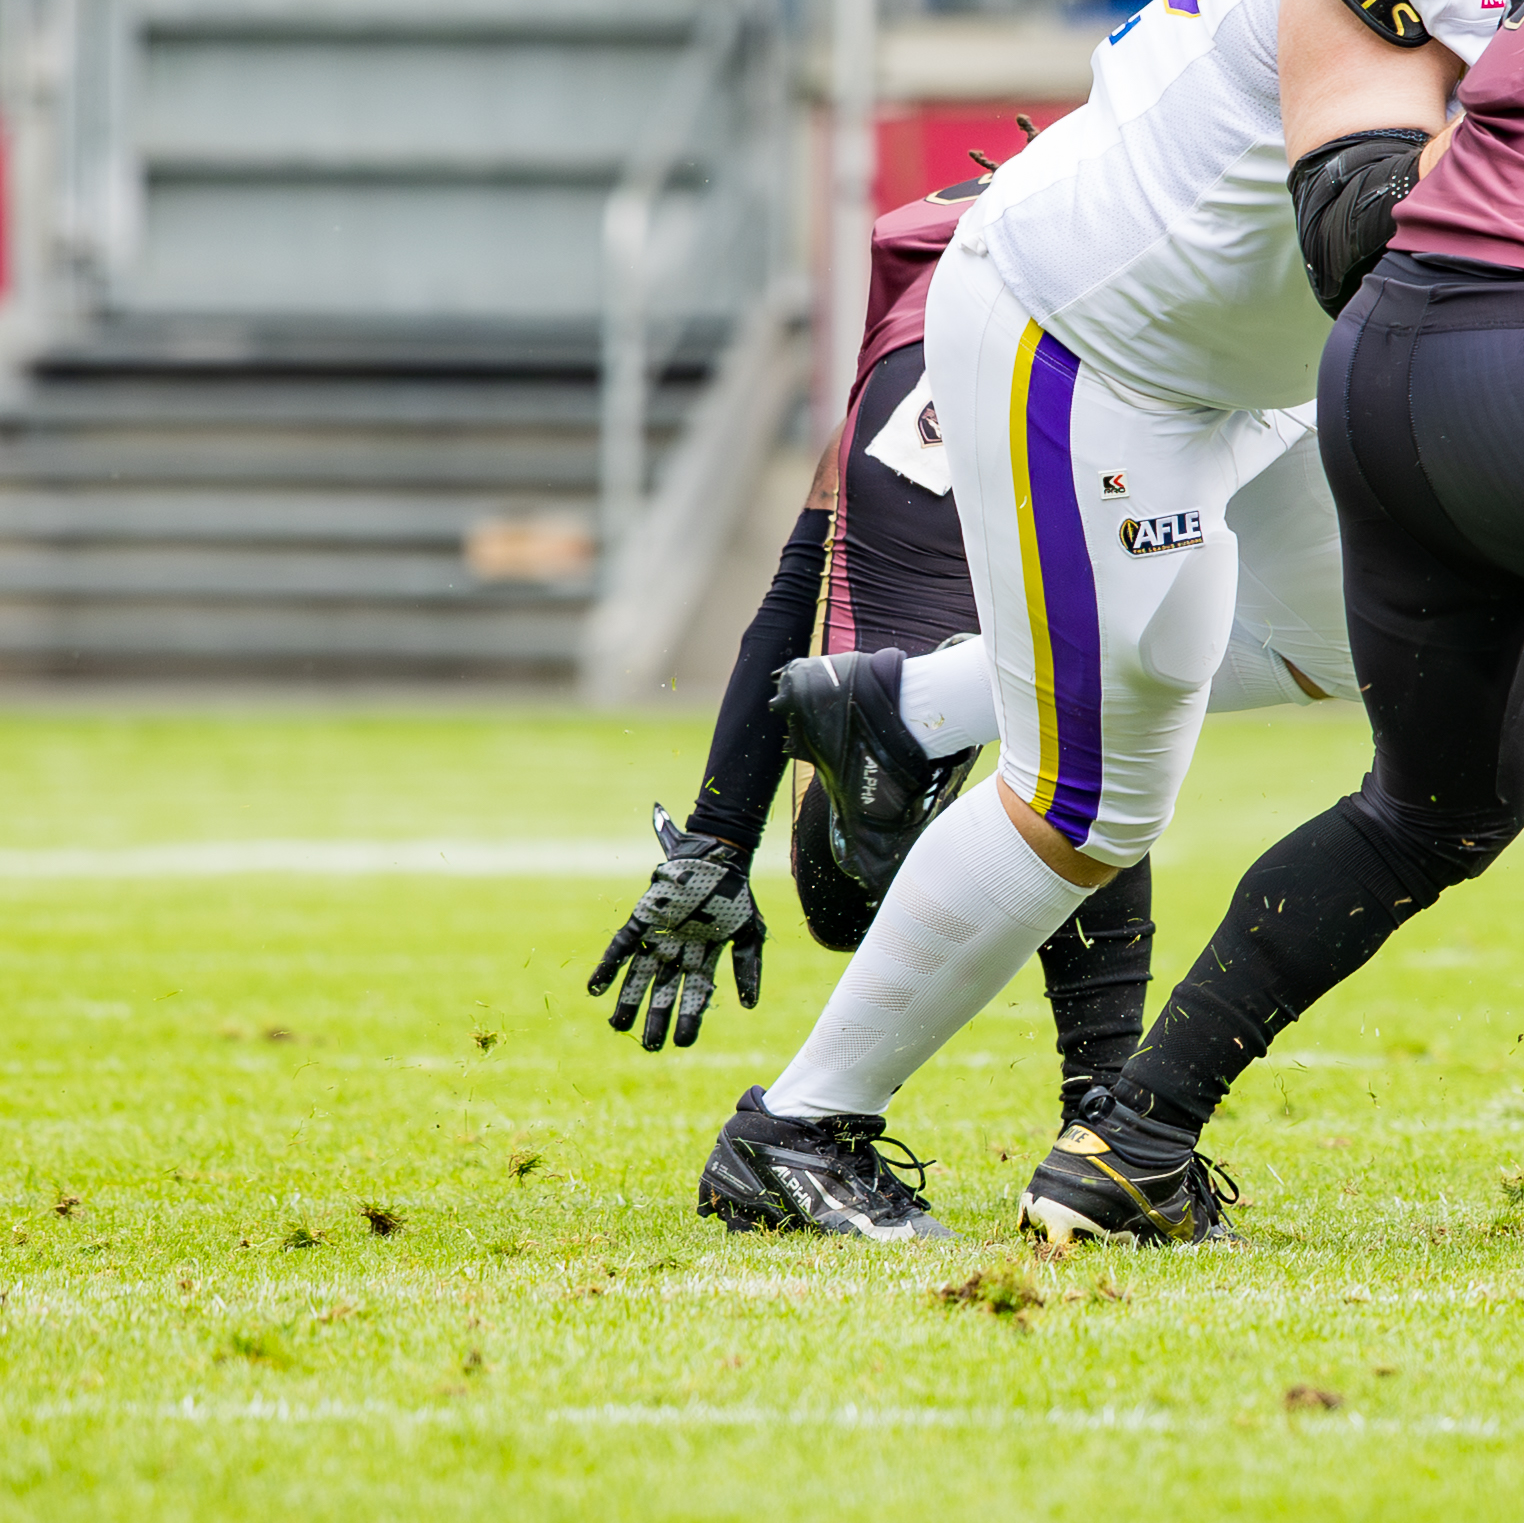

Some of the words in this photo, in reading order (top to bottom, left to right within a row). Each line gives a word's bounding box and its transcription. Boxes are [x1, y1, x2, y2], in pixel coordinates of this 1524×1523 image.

[1132, 511, 1202, 549] AFLE
[859, 754, 879, 805] ALPHA
[770, 1164, 813, 1214] ALPHA
